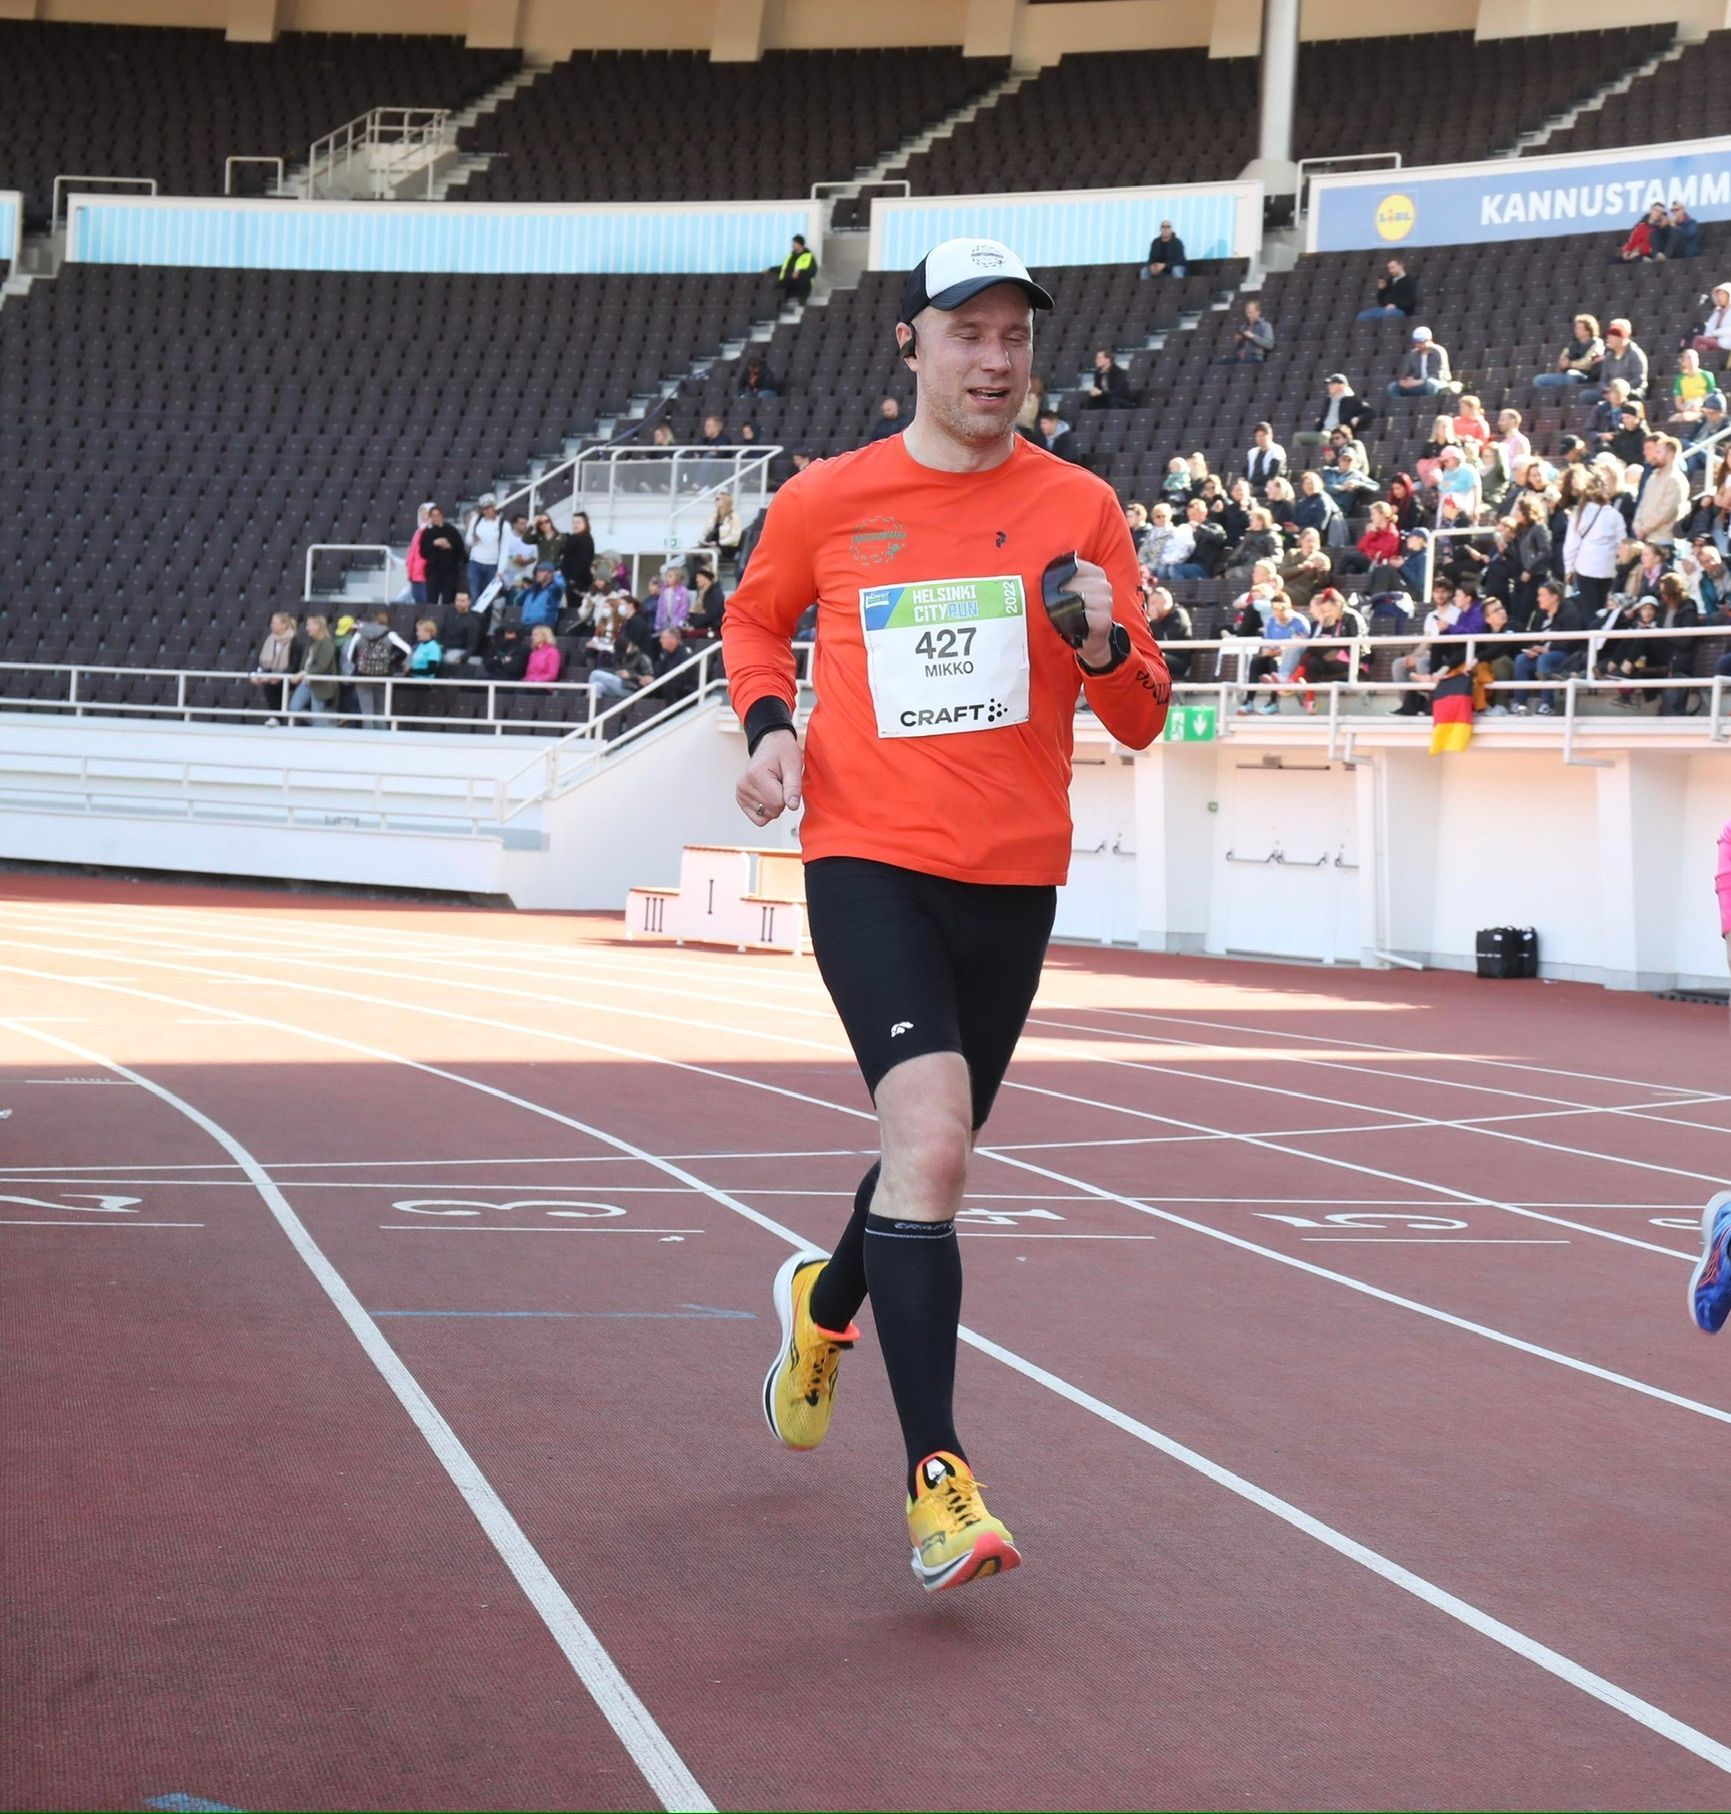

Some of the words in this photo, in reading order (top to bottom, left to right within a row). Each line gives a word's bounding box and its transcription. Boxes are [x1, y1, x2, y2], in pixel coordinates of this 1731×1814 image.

[913, 585, 977, 604] HELSINKI
[1003, 581, 1018, 613] 2022
[915, 627, 977, 659] 427
[925, 661, 974, 677] MIKKO
[900, 704, 985, 727] CRAFT
[391, 1200, 627, 1218] 3
[1253, 1212, 1469, 1230] 5
